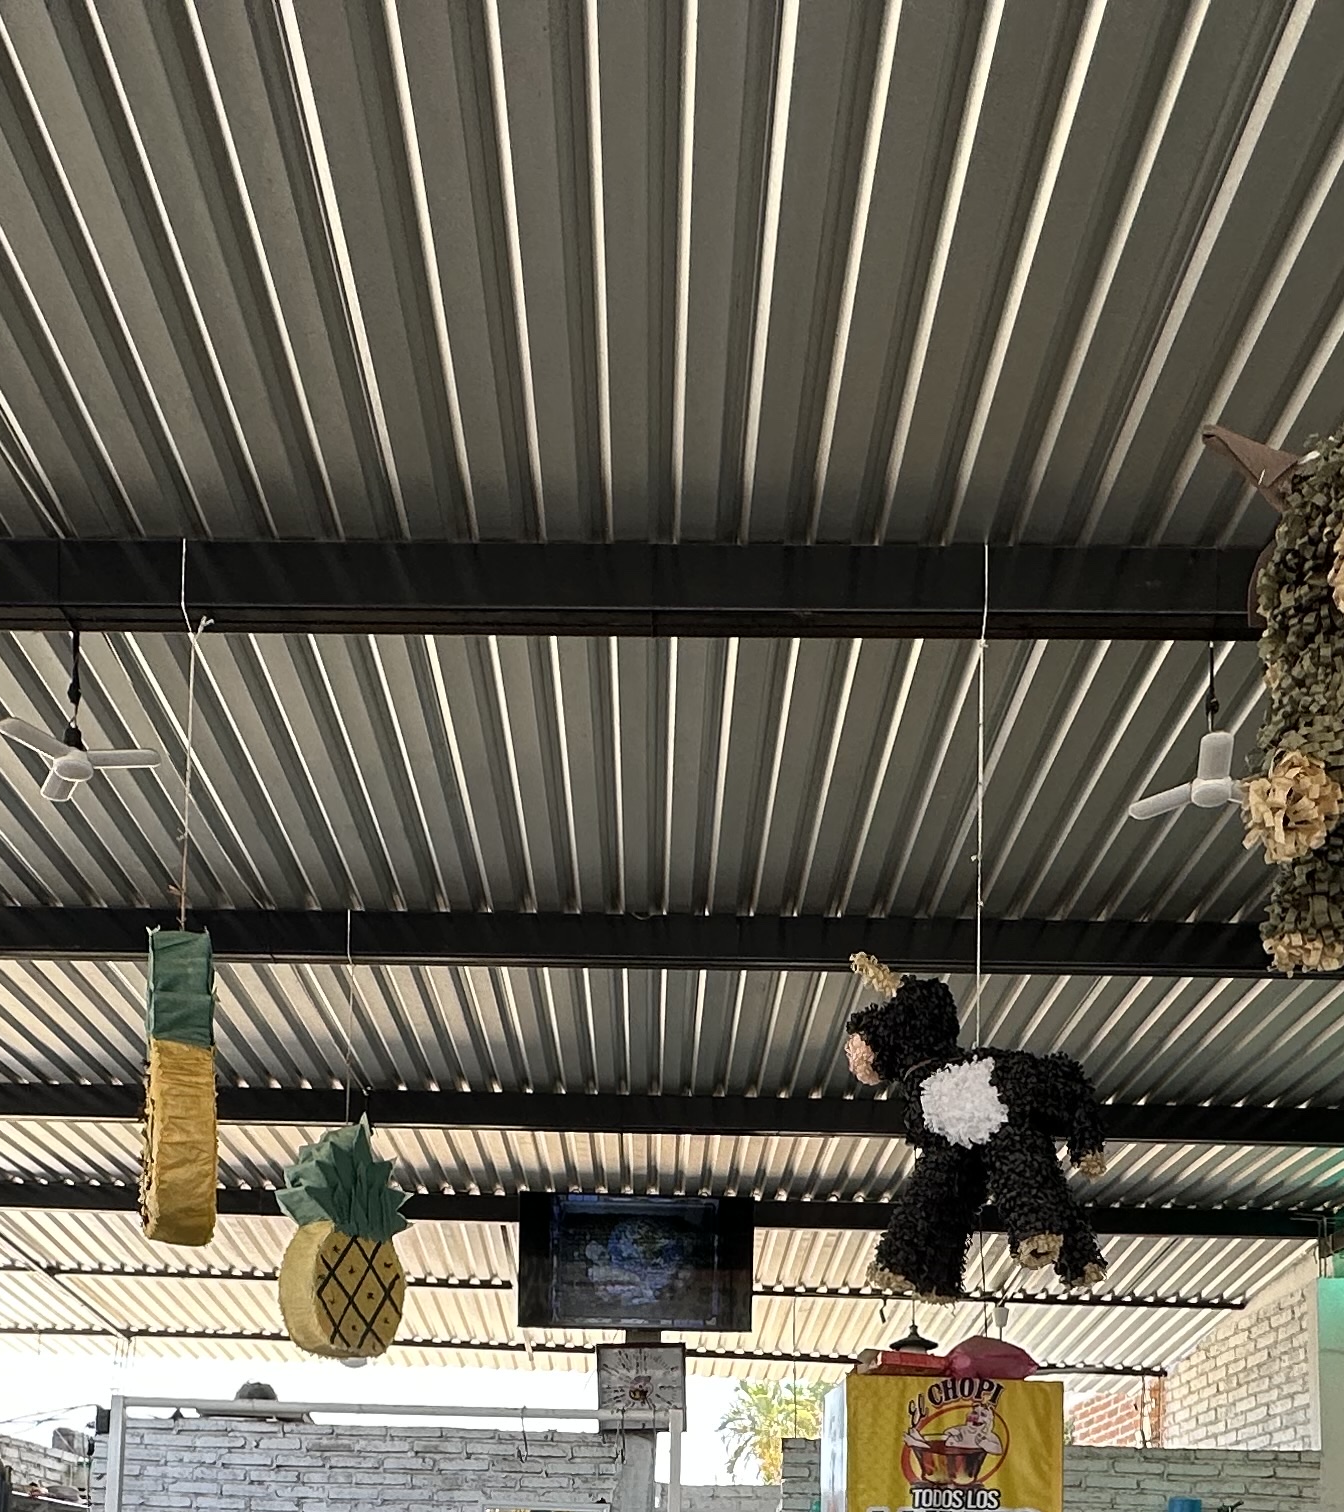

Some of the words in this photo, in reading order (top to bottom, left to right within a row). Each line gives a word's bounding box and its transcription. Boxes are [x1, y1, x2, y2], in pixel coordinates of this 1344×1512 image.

[928, 1377, 1004, 1406] CHOPI
[912, 1489, 963, 1509] TODOS
[966, 1490, 1000, 1509] LOS
